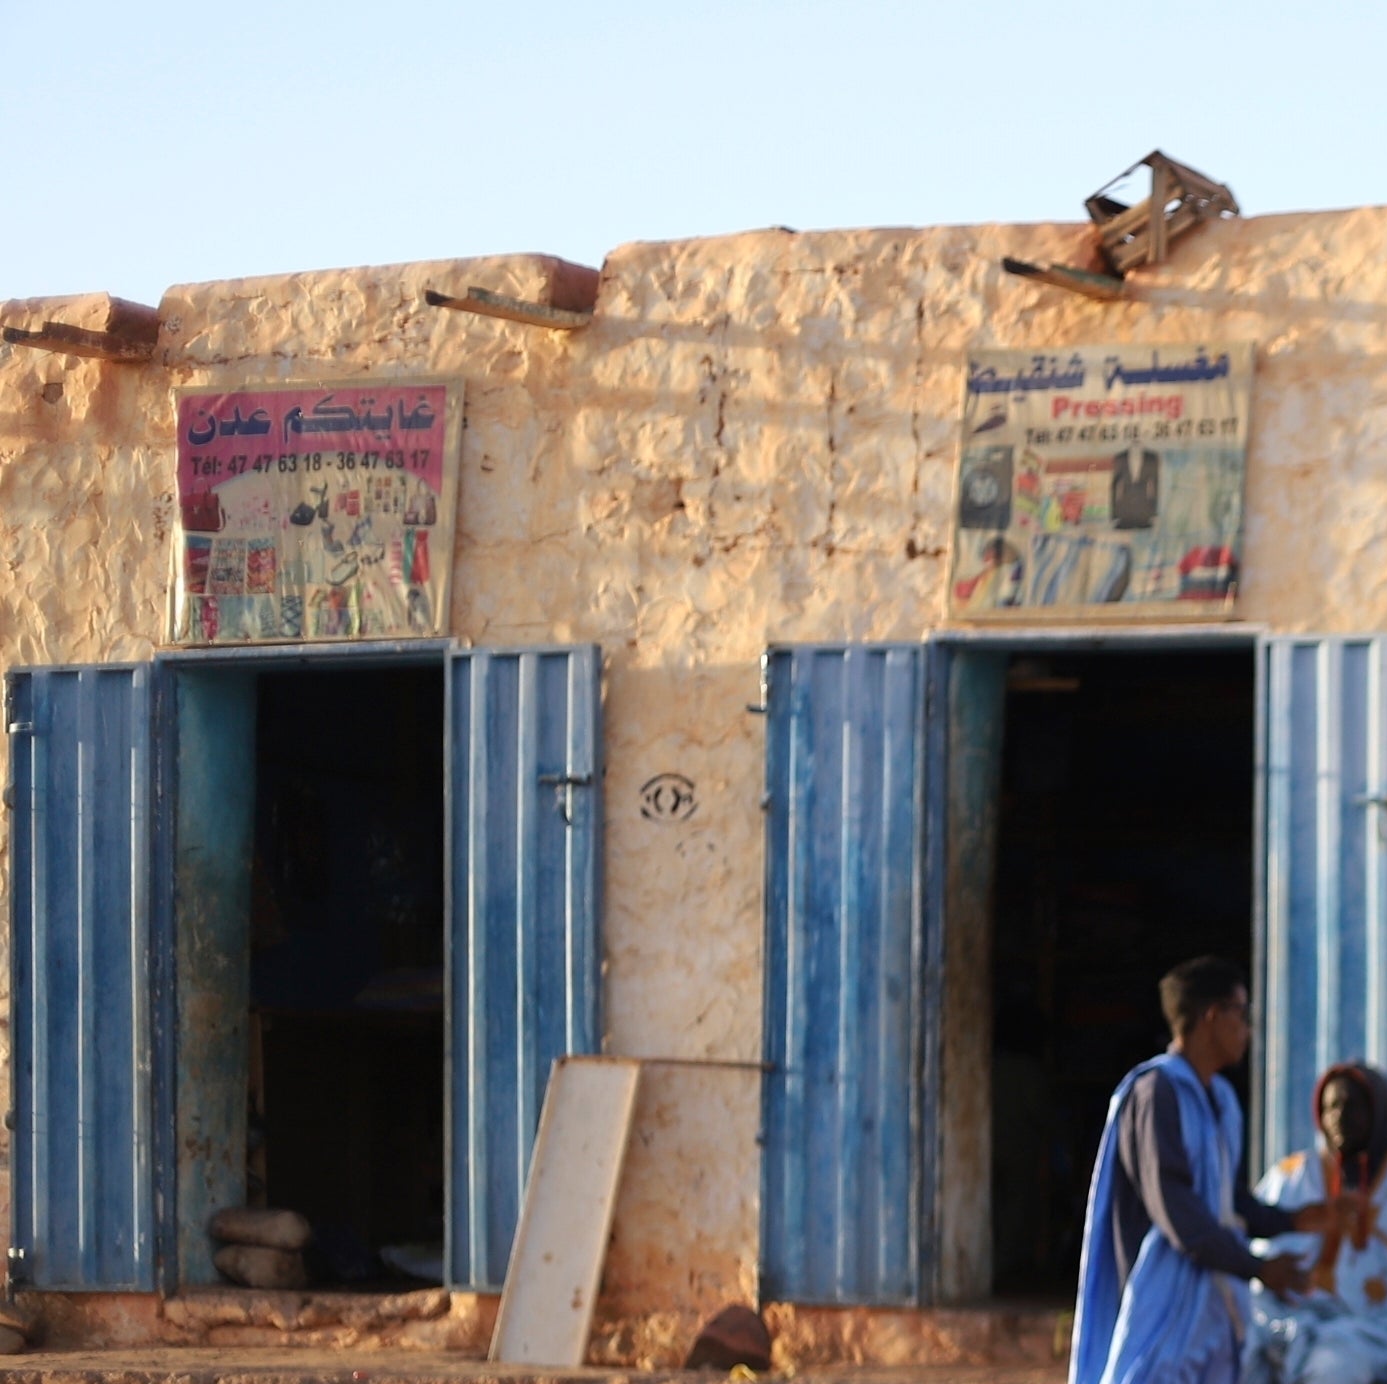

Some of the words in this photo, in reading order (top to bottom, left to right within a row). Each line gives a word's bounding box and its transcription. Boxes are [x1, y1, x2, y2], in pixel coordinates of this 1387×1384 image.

[1052, 391, 1183, 420] Pressing
[227, 454, 248, 474] 47
[252, 454, 273, 473] 47
[278, 453, 298, 472] 63
[304, 452, 322, 472] 18
[336, 451, 355, 471] 36
[360, 450, 380, 470] 47
[385, 449, 405, 469] 63
[410, 448, 431, 469] 17
